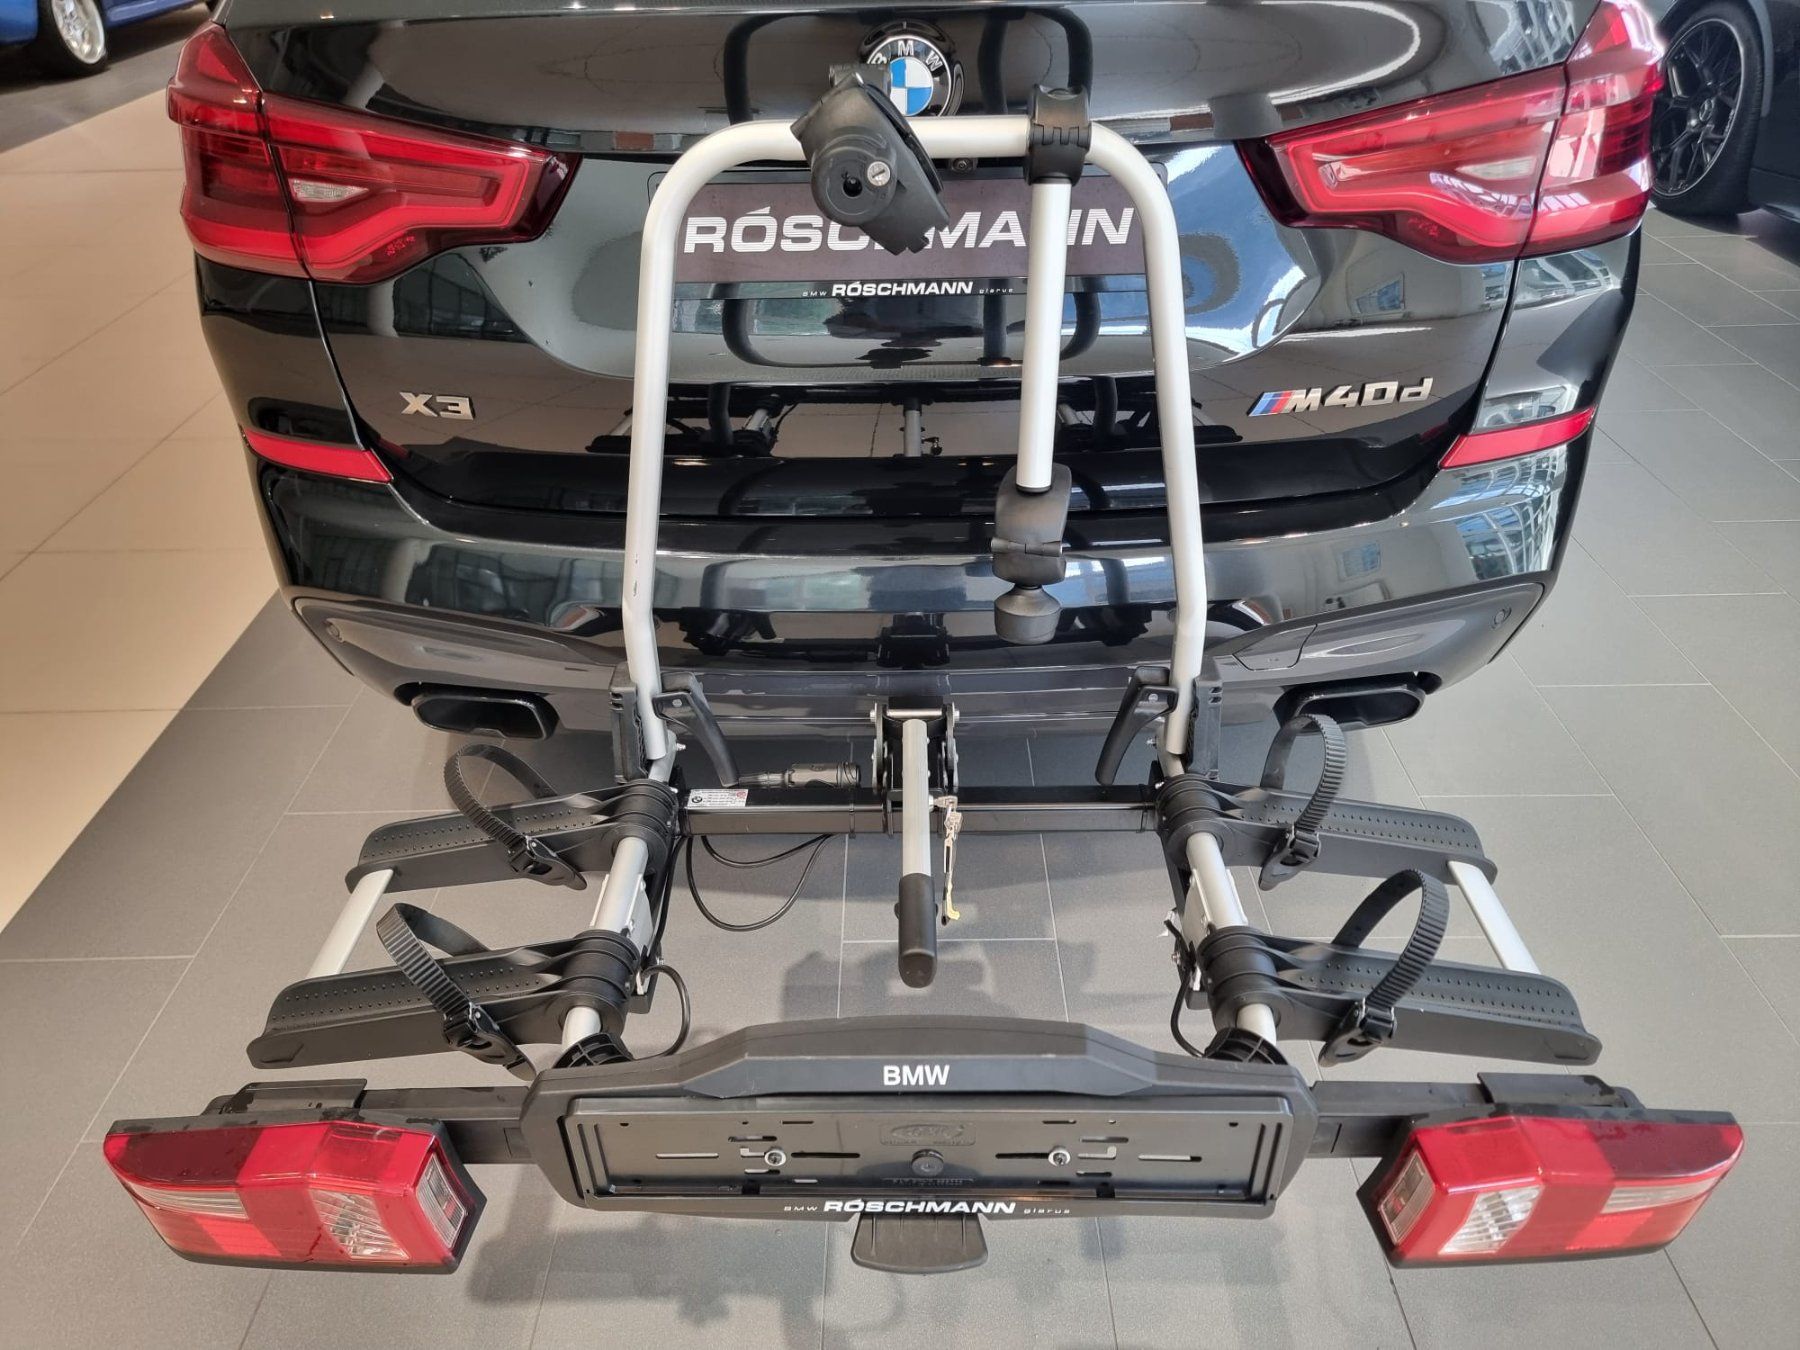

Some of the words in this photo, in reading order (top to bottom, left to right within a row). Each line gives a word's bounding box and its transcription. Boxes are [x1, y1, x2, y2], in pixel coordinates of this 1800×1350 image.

[831, 281, 974, 297] RÓSCHMANN
[399, 391, 474, 421] X3
[1279, 377, 1434, 414] M40d
[883, 1064, 951, 1086] BMW
[823, 1199, 1017, 1214] RÓSCHMANN
